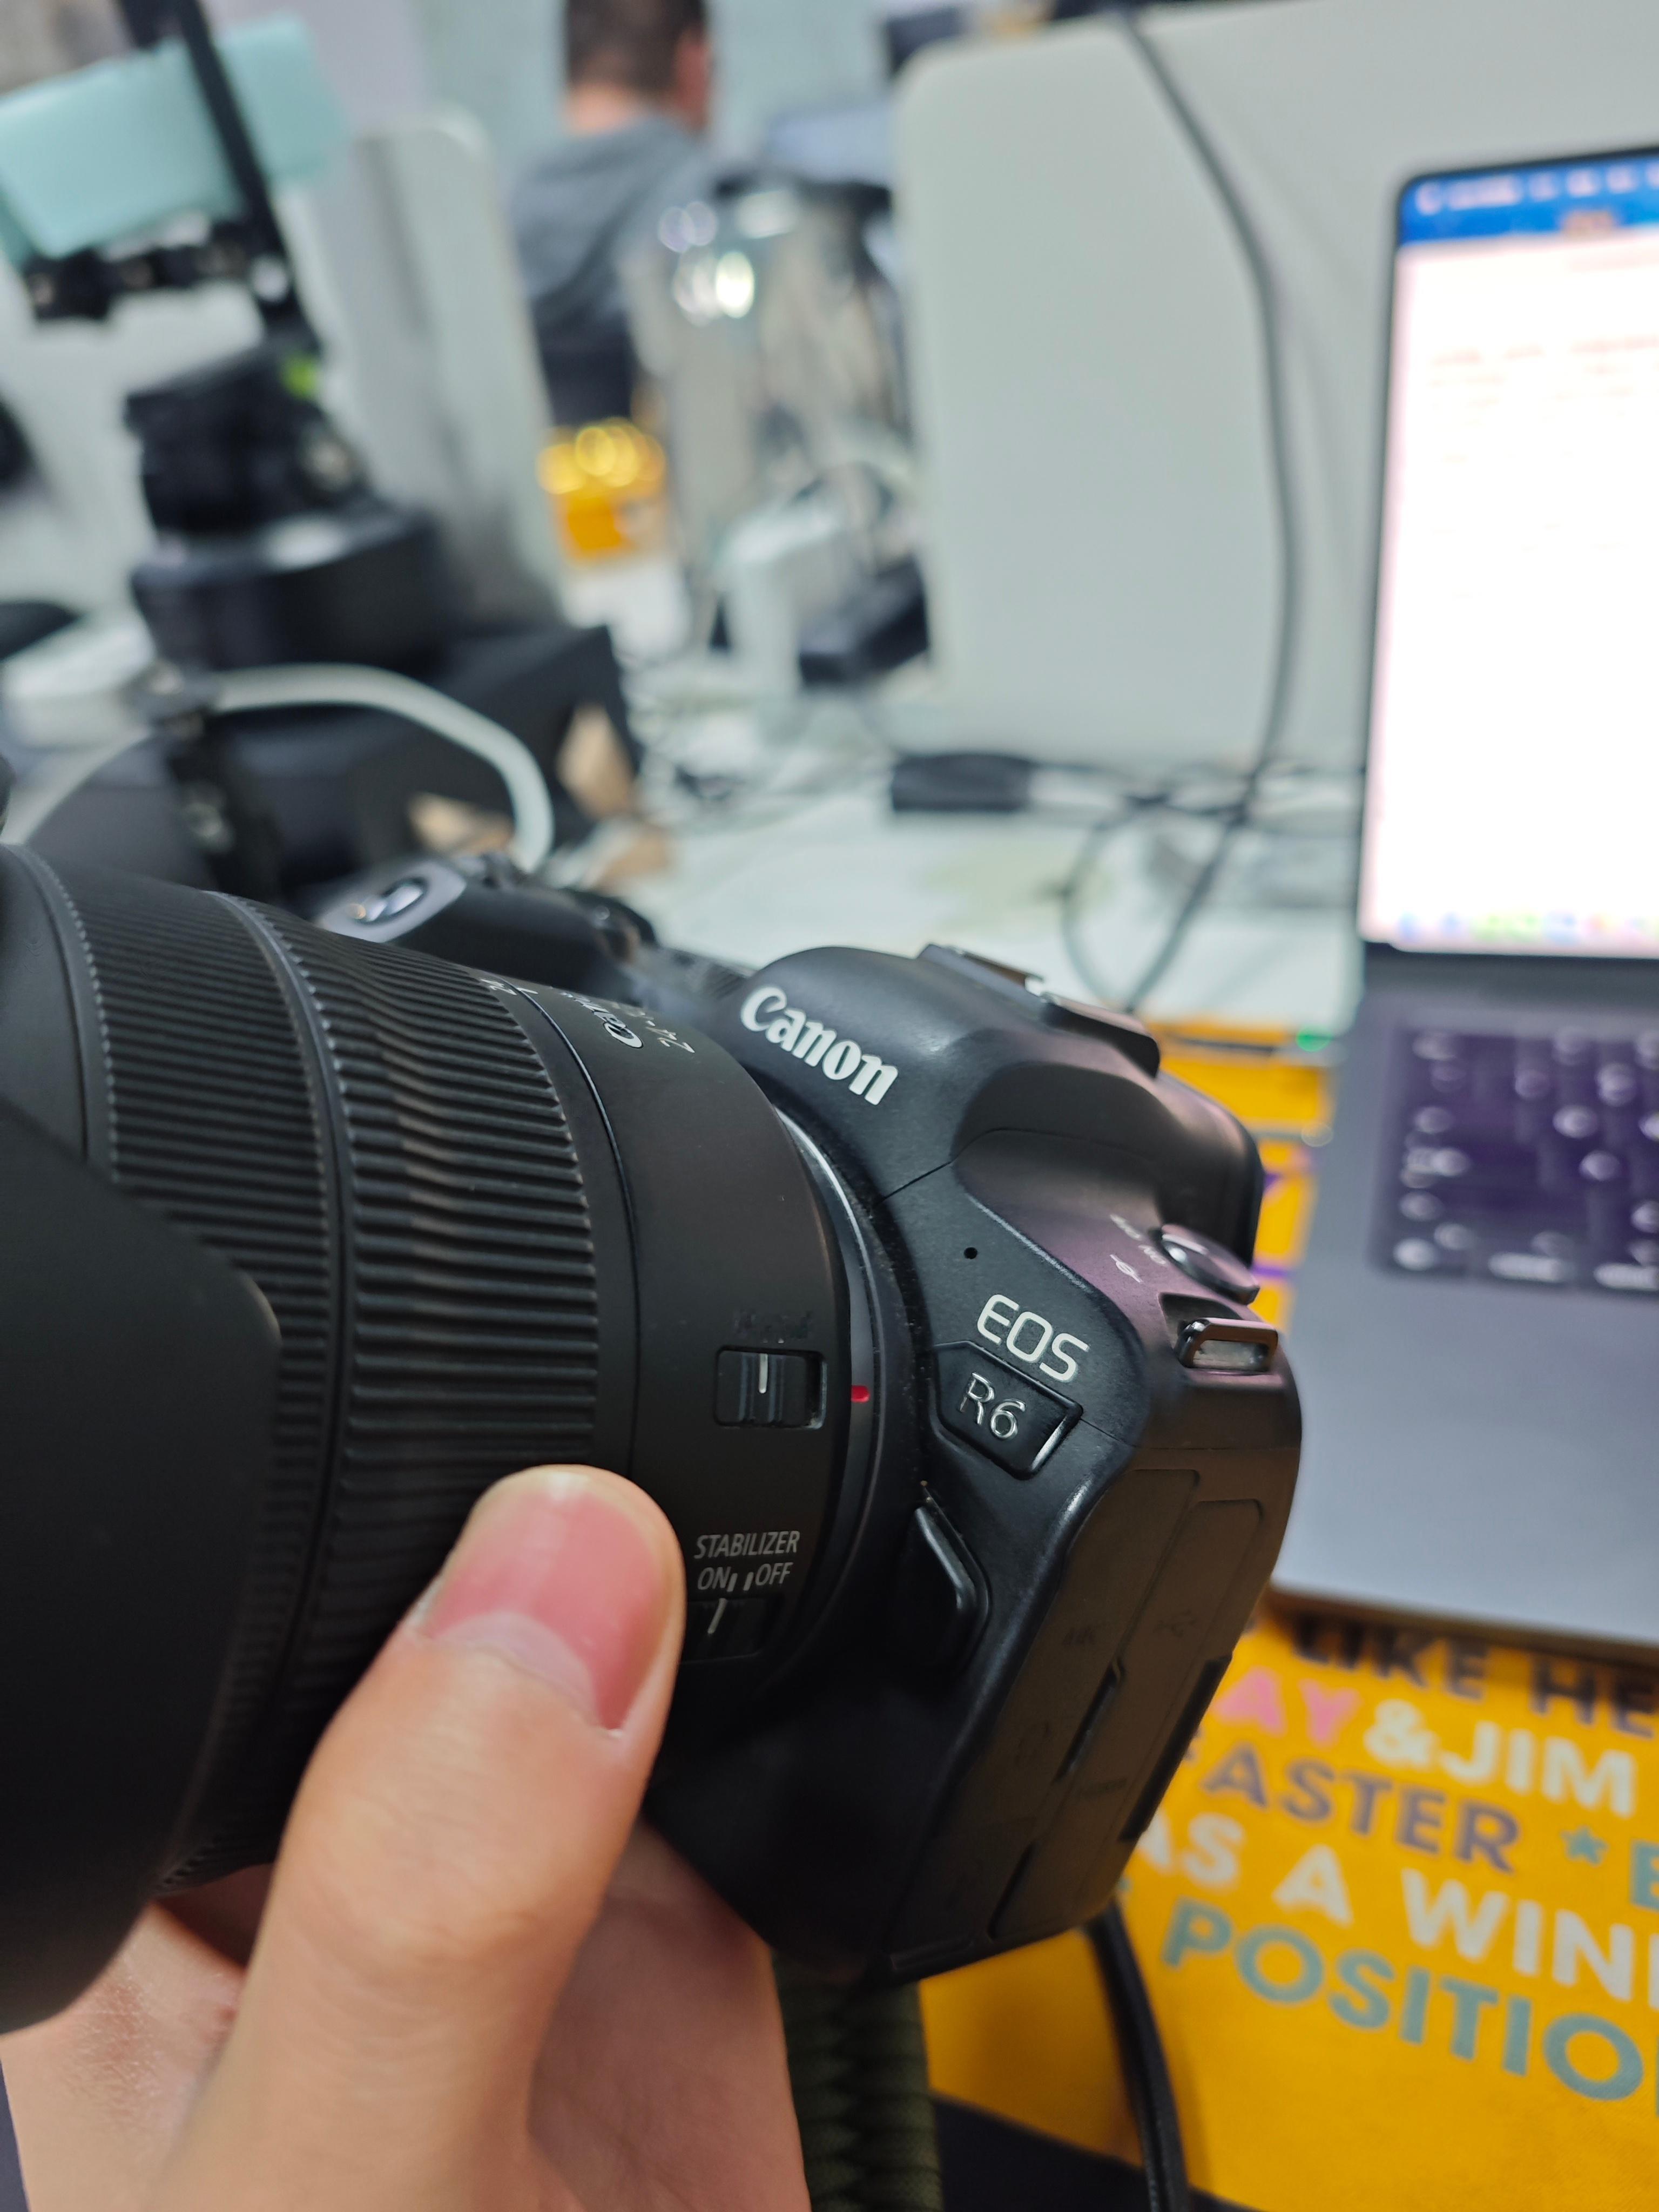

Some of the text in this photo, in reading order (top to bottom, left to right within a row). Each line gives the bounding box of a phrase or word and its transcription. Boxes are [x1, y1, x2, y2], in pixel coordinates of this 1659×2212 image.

[559, 992, 643, 1048] Can
[740, 985, 899, 1105] Canon
[977, 1294, 1090, 1382] EOS
[959, 1372, 1027, 1440] R6
[693, 1530, 800, 1560] STABILIZER
[697, 1562, 794, 1590] ON OFF
[1185, 1724, 1521, 1874] ASTER
[1272, 1843, 1354, 1927] A
[1400, 1867, 1659, 2013] WIN
[1161, 1894, 1659, 2118] POSITIO
